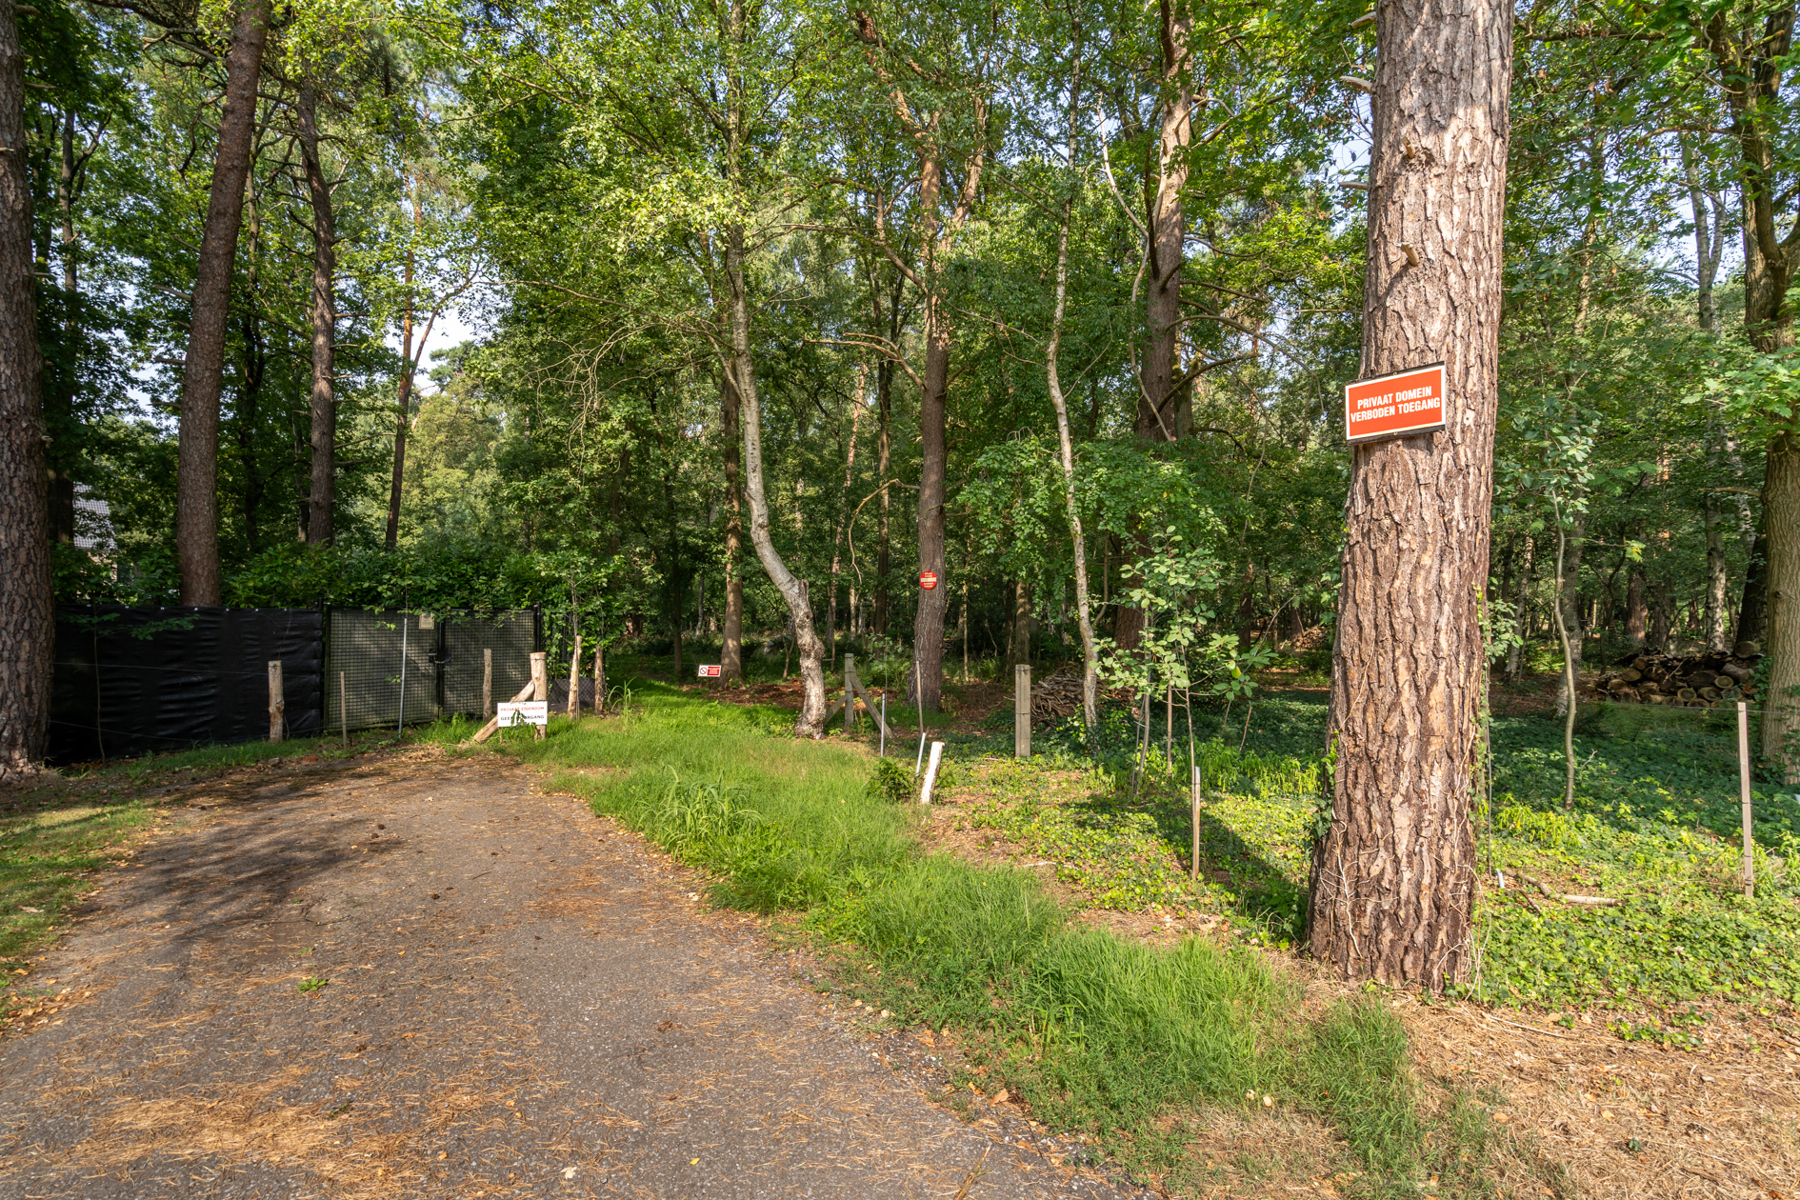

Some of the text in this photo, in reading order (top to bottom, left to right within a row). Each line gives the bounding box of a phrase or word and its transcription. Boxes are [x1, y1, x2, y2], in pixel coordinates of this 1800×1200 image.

[1350, 397, 1440, 423] VERBODEN TOEGANG
[1357, 385, 1432, 410] PRIVAAT DOMEIN
